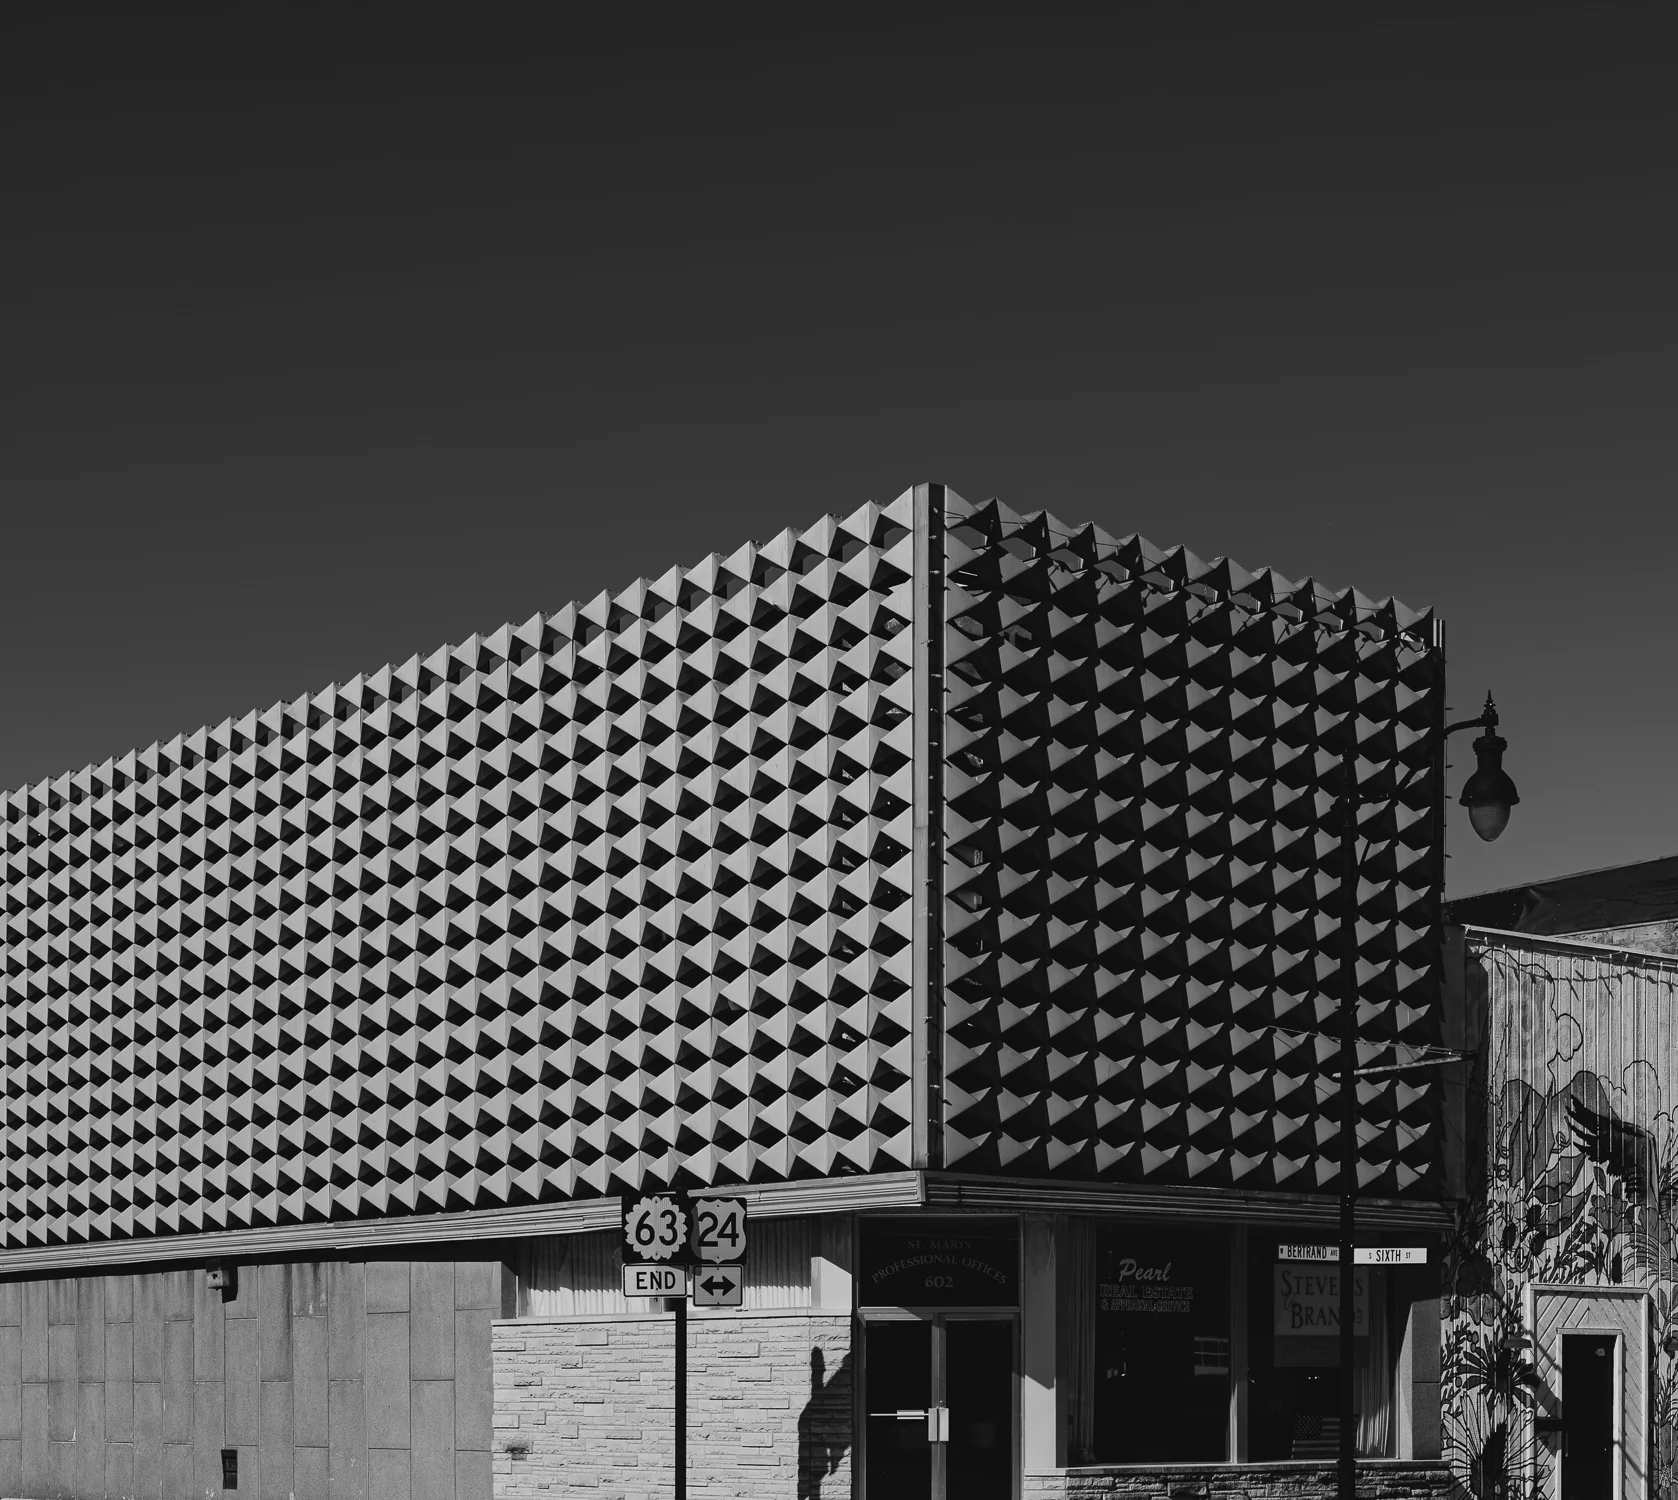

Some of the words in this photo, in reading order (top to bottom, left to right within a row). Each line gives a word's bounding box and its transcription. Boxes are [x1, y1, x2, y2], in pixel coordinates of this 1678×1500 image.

[635, 1209, 678, 1246] 63
[697, 1211, 740, 1248] 24
[1287, 1245, 1327, 1259] BERTRAND
[1330, 1249, 1338, 1257] AVE
[1368, 1252, 1372, 1260] S
[1376, 1249, 1401, 1262] SIXTH
[871, 1253, 958, 1284] PROFESSIONAL
[961, 1256, 1008, 1284] OFFICES
[1118, 1258, 1172, 1282] Pearl
[636, 1271, 676, 1290] END
[924, 1276, 954, 1289] 602
[1280, 1270, 1363, 1297] STEVES
[1099, 1283, 1139, 1298] REAL
[1142, 1285, 1194, 1300] ESTATE
[1100, 1298, 1109, 1311] &
[1291, 1303, 1355, 1329] BRAN
